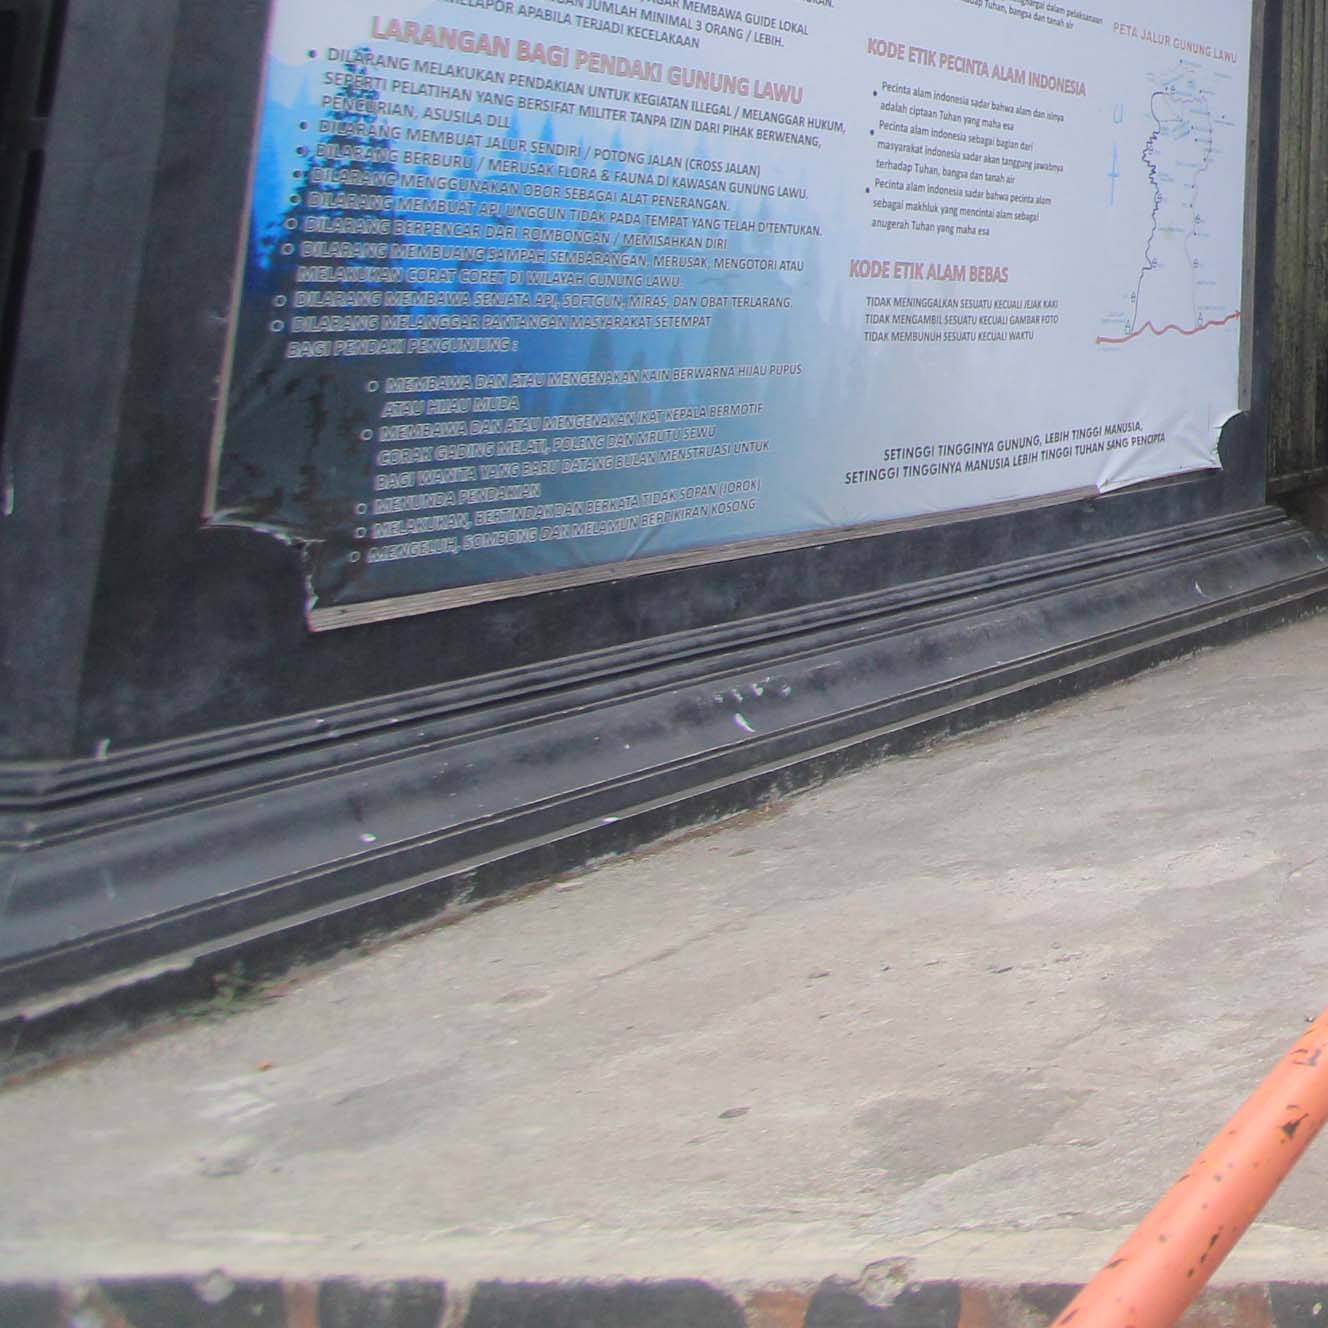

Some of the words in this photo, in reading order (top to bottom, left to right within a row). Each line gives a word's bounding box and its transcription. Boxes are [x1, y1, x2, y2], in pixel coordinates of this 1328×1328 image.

[517, 3, 572, 27] APABILA
[576, 14, 623, 36] TERJADI
[626, 23, 699, 49] KECELAKAAN
[368, 14, 510, 60] LARANGAN
[515, 38, 569, 69] BAGI
[574, 48, 662, 84] PENDAKI
[666, 63, 750, 97] GUNUNG
[753, 78, 803, 105] LAWU
[867, 37, 905, 61] KODE
[908, 45, 936, 67] ETIK
[939, 52, 989, 78] PECINTA
[991, 62, 1025, 85] ALAM
[1028, 70, 1086, 97] INDONESIA
[848, 259, 890, 279] KODE
[893, 261, 923, 280] ETIK
[926, 263, 965, 282] ALAM
[969, 265, 1008, 283] BEBAS
[844, 466, 899, 485] SETINGGI
[903, 459, 961, 478] TINGGINYA
[964, 453, 1009, 471] MANUSIA
[1012, 450, 1038, 464] LEBIH
[1041, 445, 1072, 460] TINGGI
[1075, 441, 1104, 456] TUHAN
[1106, 438, 1128, 451] SANG
[883, 445, 934, 461] SETINGGI
[938, 439, 994, 456] TINGGINYA
[1044, 431, 1069, 445] LEBIH
[1072, 427, 1102, 441] TINGGI
